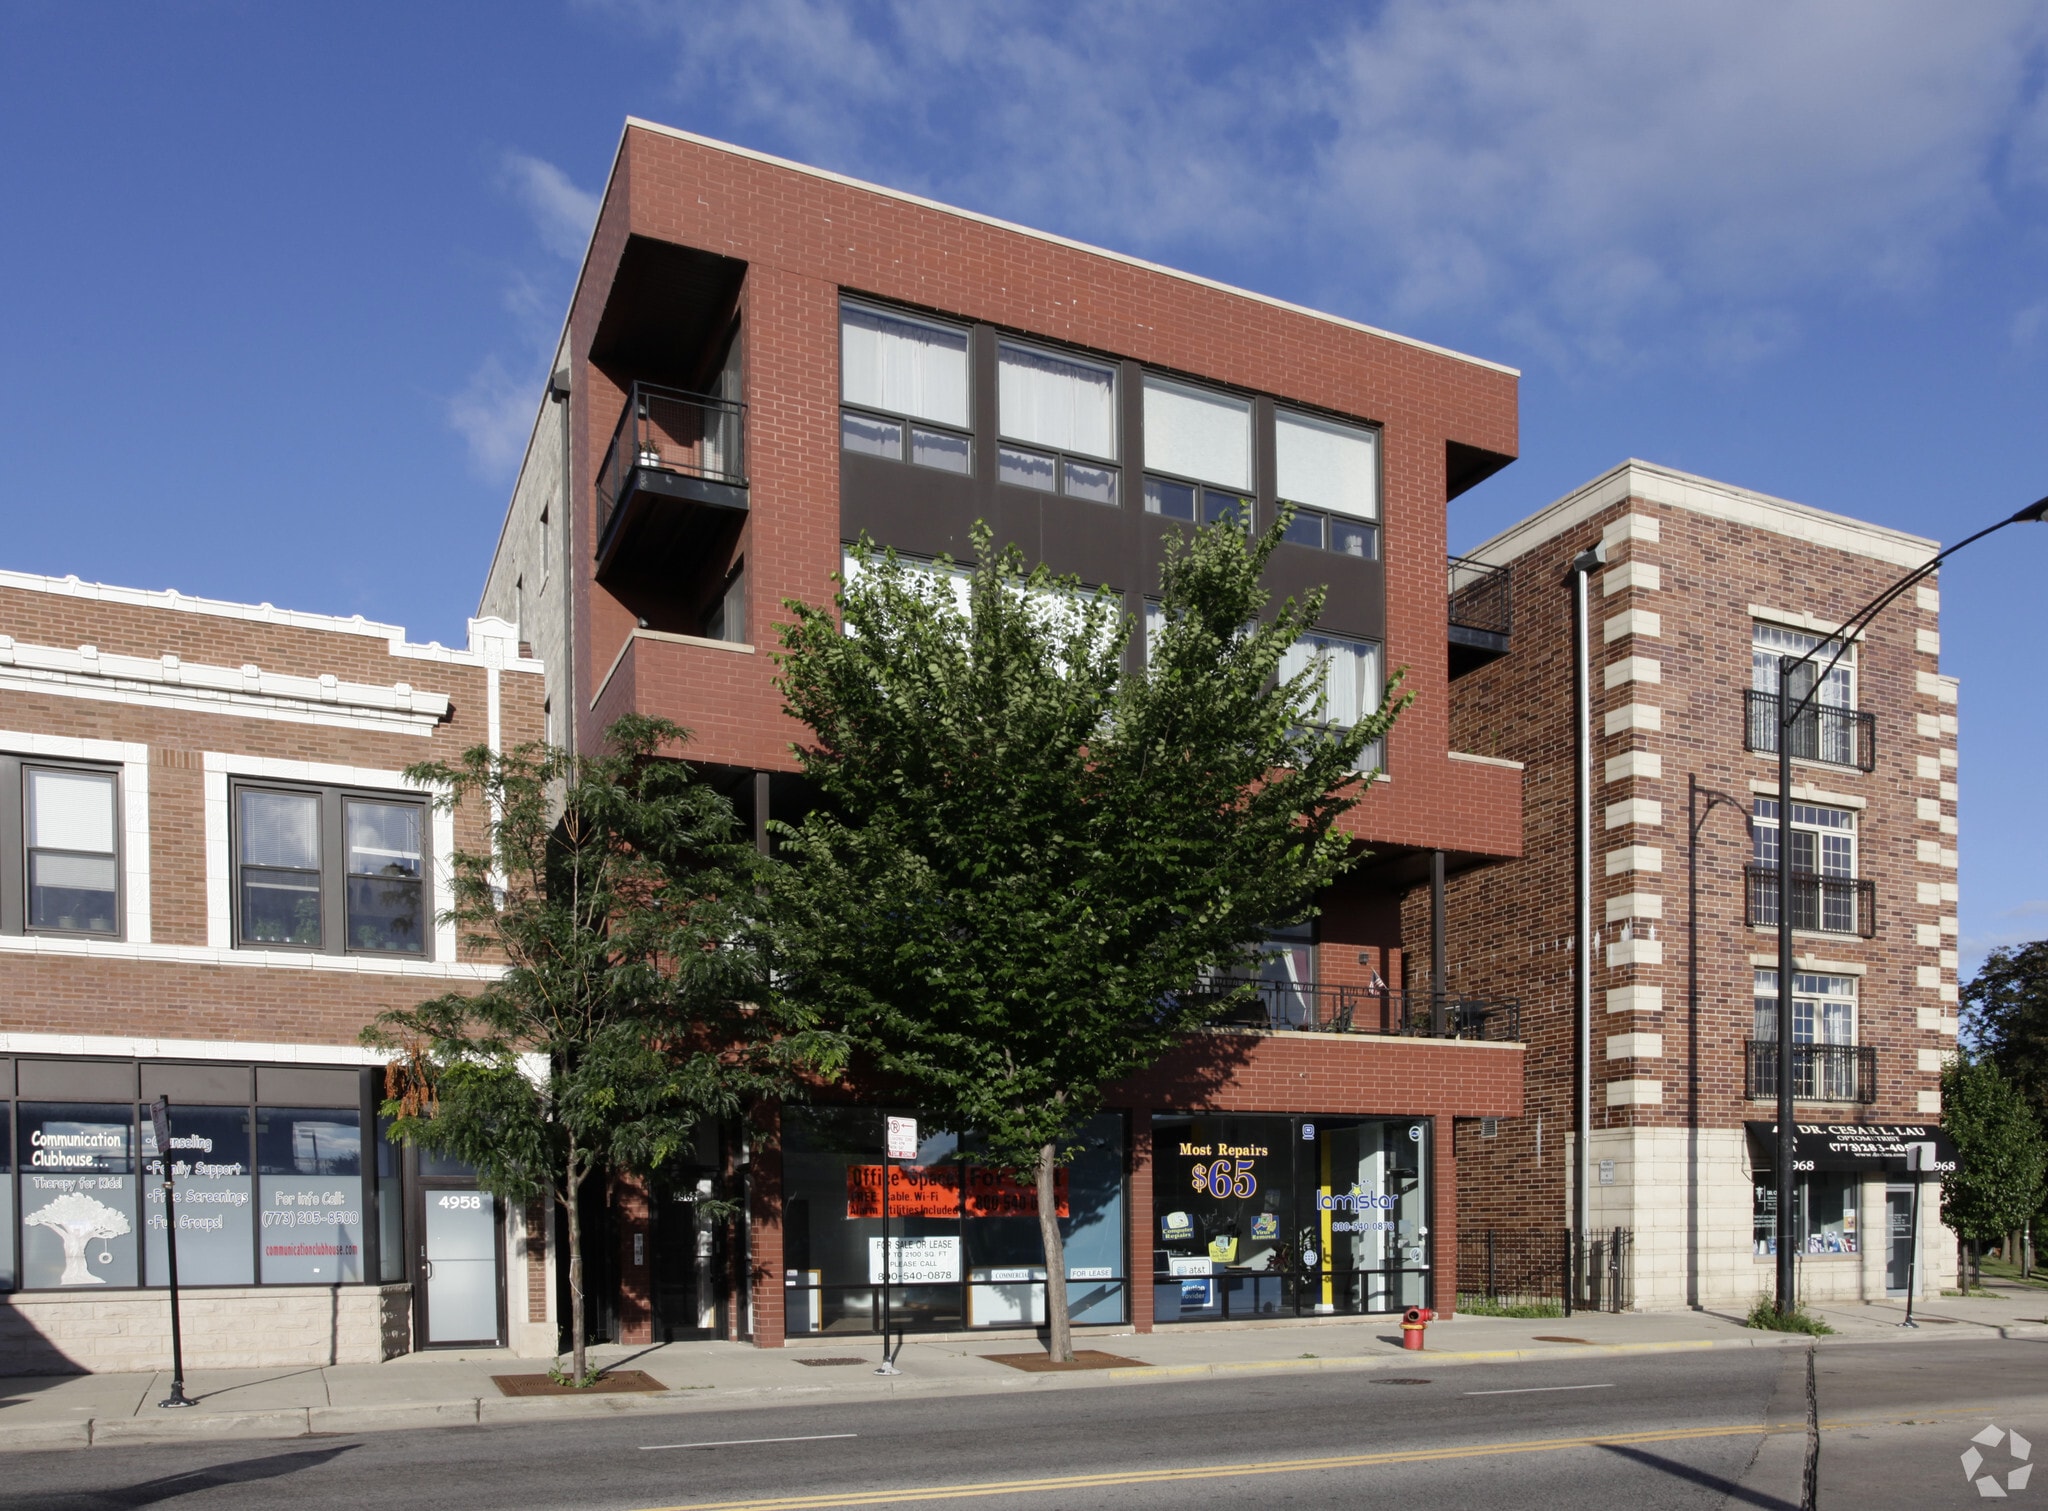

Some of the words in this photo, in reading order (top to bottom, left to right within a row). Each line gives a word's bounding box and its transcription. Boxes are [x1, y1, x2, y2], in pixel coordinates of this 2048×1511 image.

[1796, 1124, 1828, 1135] DR.
[1828, 1125, 1880, 1136] CESAR
[1880, 1126, 1895, 1136] L.
[1895, 1126, 1926, 1137] LAU
[1836, 1134, 1901, 1142] OPTOMETRIST
[31, 1130, 121, 1147] Communication
[32, 1149, 109, 1167] Clubhouse...
[1179, 1142, 1213, 1156] Most
[1217, 1143, 1269, 1159] Repairs
[195, 1161, 242, 1179] Support
[1792, 1160, 1816, 1171] 968
[1934, 1161, 1956, 1171] 968
[971, 1166, 1004, 1186] For
[1191, 1159, 1257, 1199] $65
[33, 1176, 76, 1192] Therapy
[79, 1176, 96, 1189] for
[98, 1176, 123, 1189] Kids!
[152, 1188, 182, 1203] Fre
[185, 1188, 249, 1207] Screenings
[275, 1191, 296, 1206] For
[297, 1191, 320, 1206] info
[321, 1191, 345, 1206] Call:
[438, 1195, 481, 1210] 4958
[914, 1191, 939, 1201] Wi-Fi
[1316, 1188, 1400, 1214] lamistar
[889, 1205, 919, 1215] tilities
[153, 1214, 177, 1230] Fu
[179, 1214, 224, 1232] Groups!
[261, 1211, 296, 1228] (773)
[297, 1211, 359, 1225] 205-8500
[265, 1242, 358, 1257] communicationclubhouse.com
[895, 1240, 914, 1249] SALE
[916, 1240, 927, 1249] OR
[929, 1239, 952, 1249] LEASE
[877, 1270, 952, 1281] 80-540-0878
[1072, 1270, 1087, 1278] FOR
[1089, 1269, 1109, 1277] LEASE
[1188, 1265, 1207, 1274] at&t
[1182, 1284, 1206, 1292] olution
